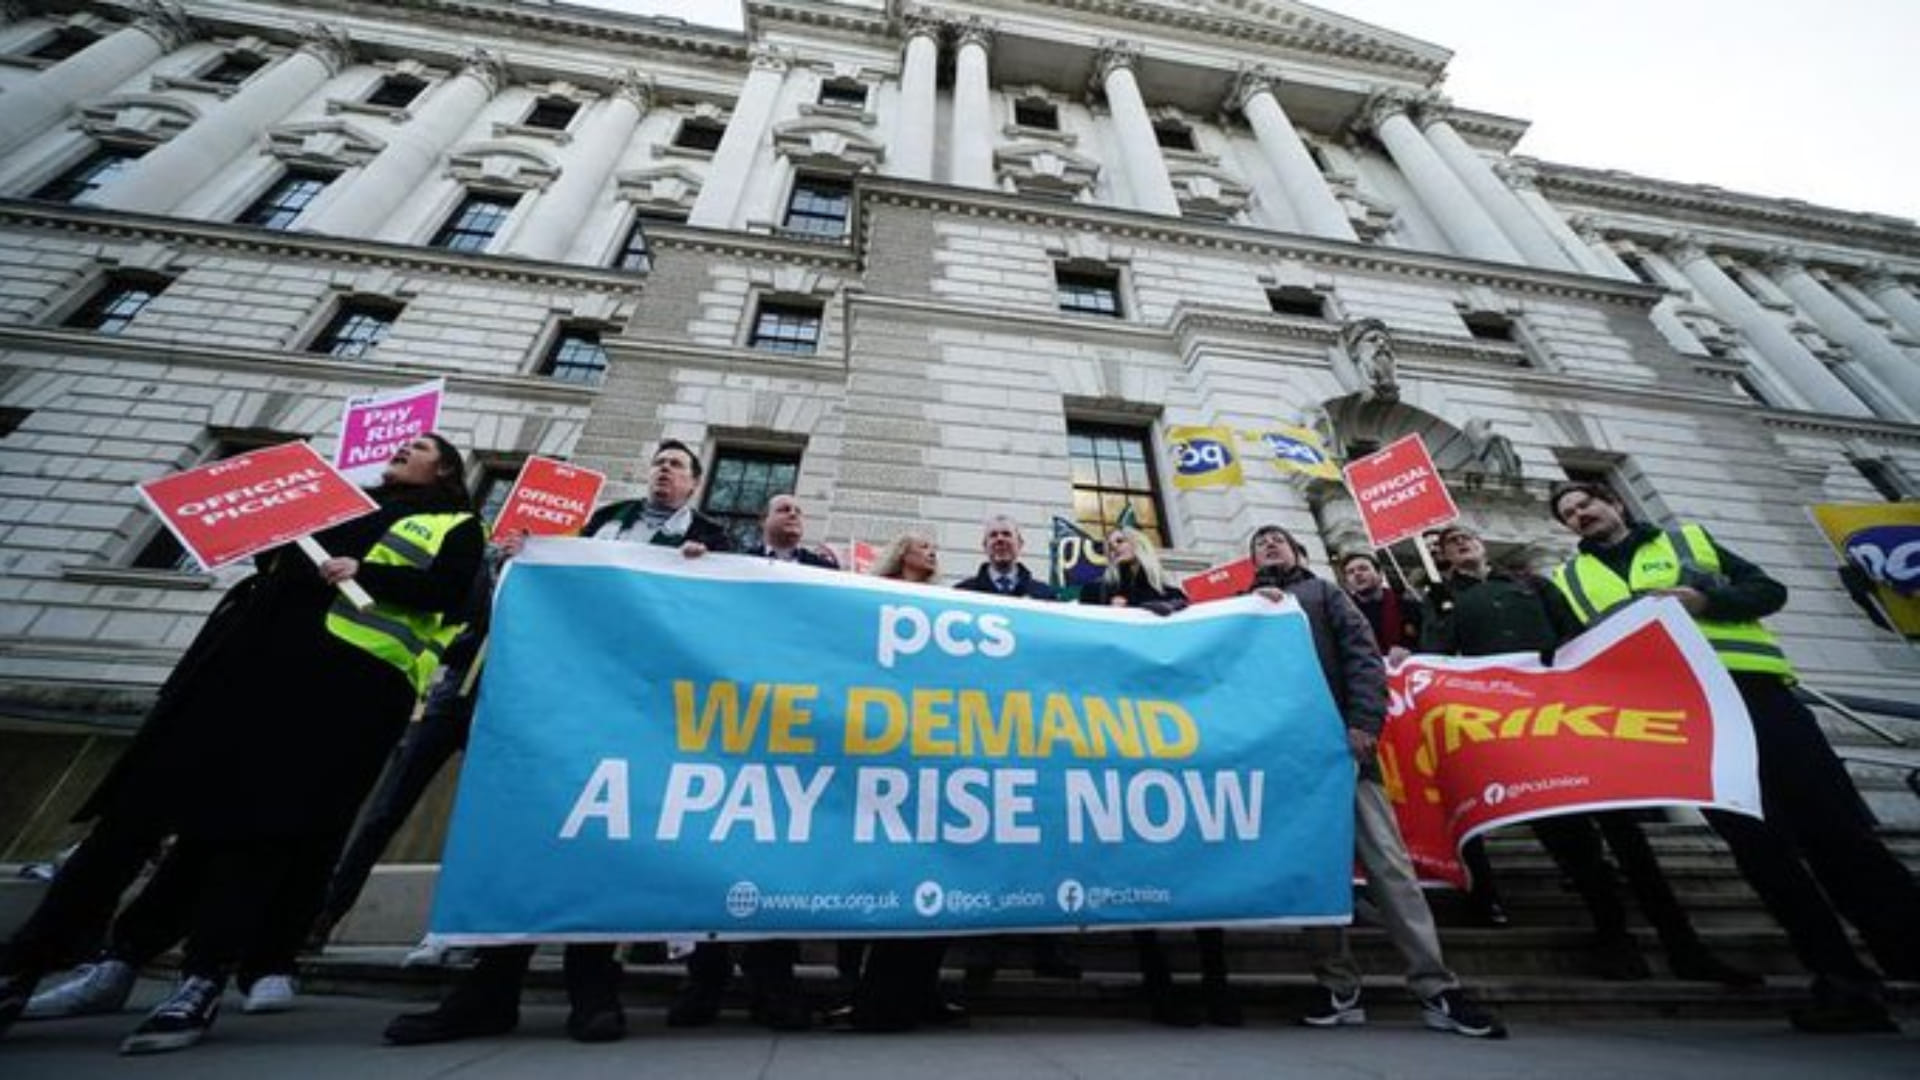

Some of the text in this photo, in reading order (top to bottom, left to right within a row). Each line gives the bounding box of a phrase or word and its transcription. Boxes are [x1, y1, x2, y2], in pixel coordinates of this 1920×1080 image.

[363, 405, 413, 427] Pay
[367, 420, 421, 442] Rise
[176, 467, 326, 517] OFFICIAL
[517, 486, 585, 513] OFFICIAL
[1360, 466, 1430, 502] OFFICIAL
[1370, 480, 1428, 513] PICKET
[201, 480, 322, 526] PICKET
[516, 502, 578, 527] PICKET
[1058, 536, 1111, 587] pc
[878, 603, 1016, 668] pcs
[672, 678, 1200, 759] WE DEMAND
[557, 756, 1266, 844] A PAY RISE NOW
[761, 889, 901, 915] www.pcs.org.uk
[946, 888, 1045, 911] @pcs_union
